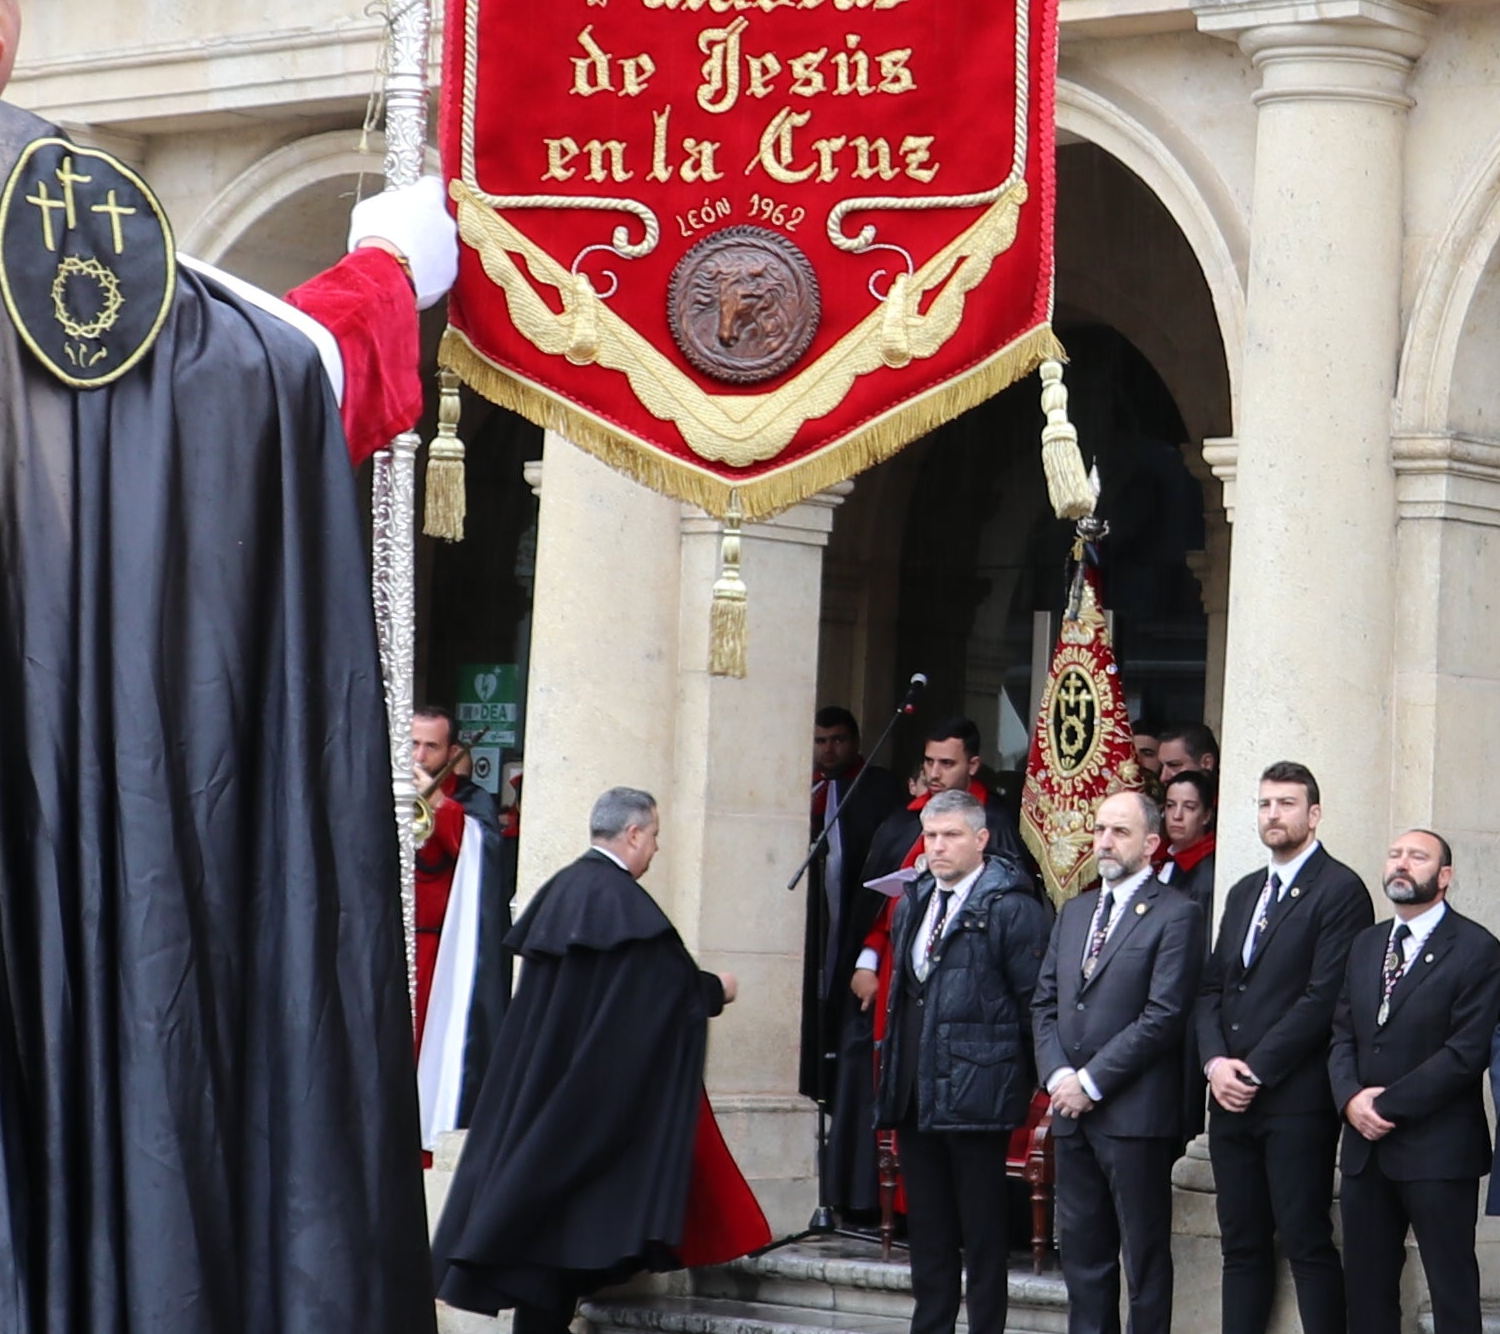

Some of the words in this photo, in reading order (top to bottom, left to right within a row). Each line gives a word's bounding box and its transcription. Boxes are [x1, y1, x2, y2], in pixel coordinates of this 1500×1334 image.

[569, 24, 656, 97] de
[696, 15, 917, 114] Jesús
[541, 137, 634, 183] en
[645, 104, 724, 183] la
[744, 105, 940, 185] Cruz
[675, 197, 731, 237] LEÓN
[748, 193, 806, 232] 1962
[480, 704, 508, 720] DEA
